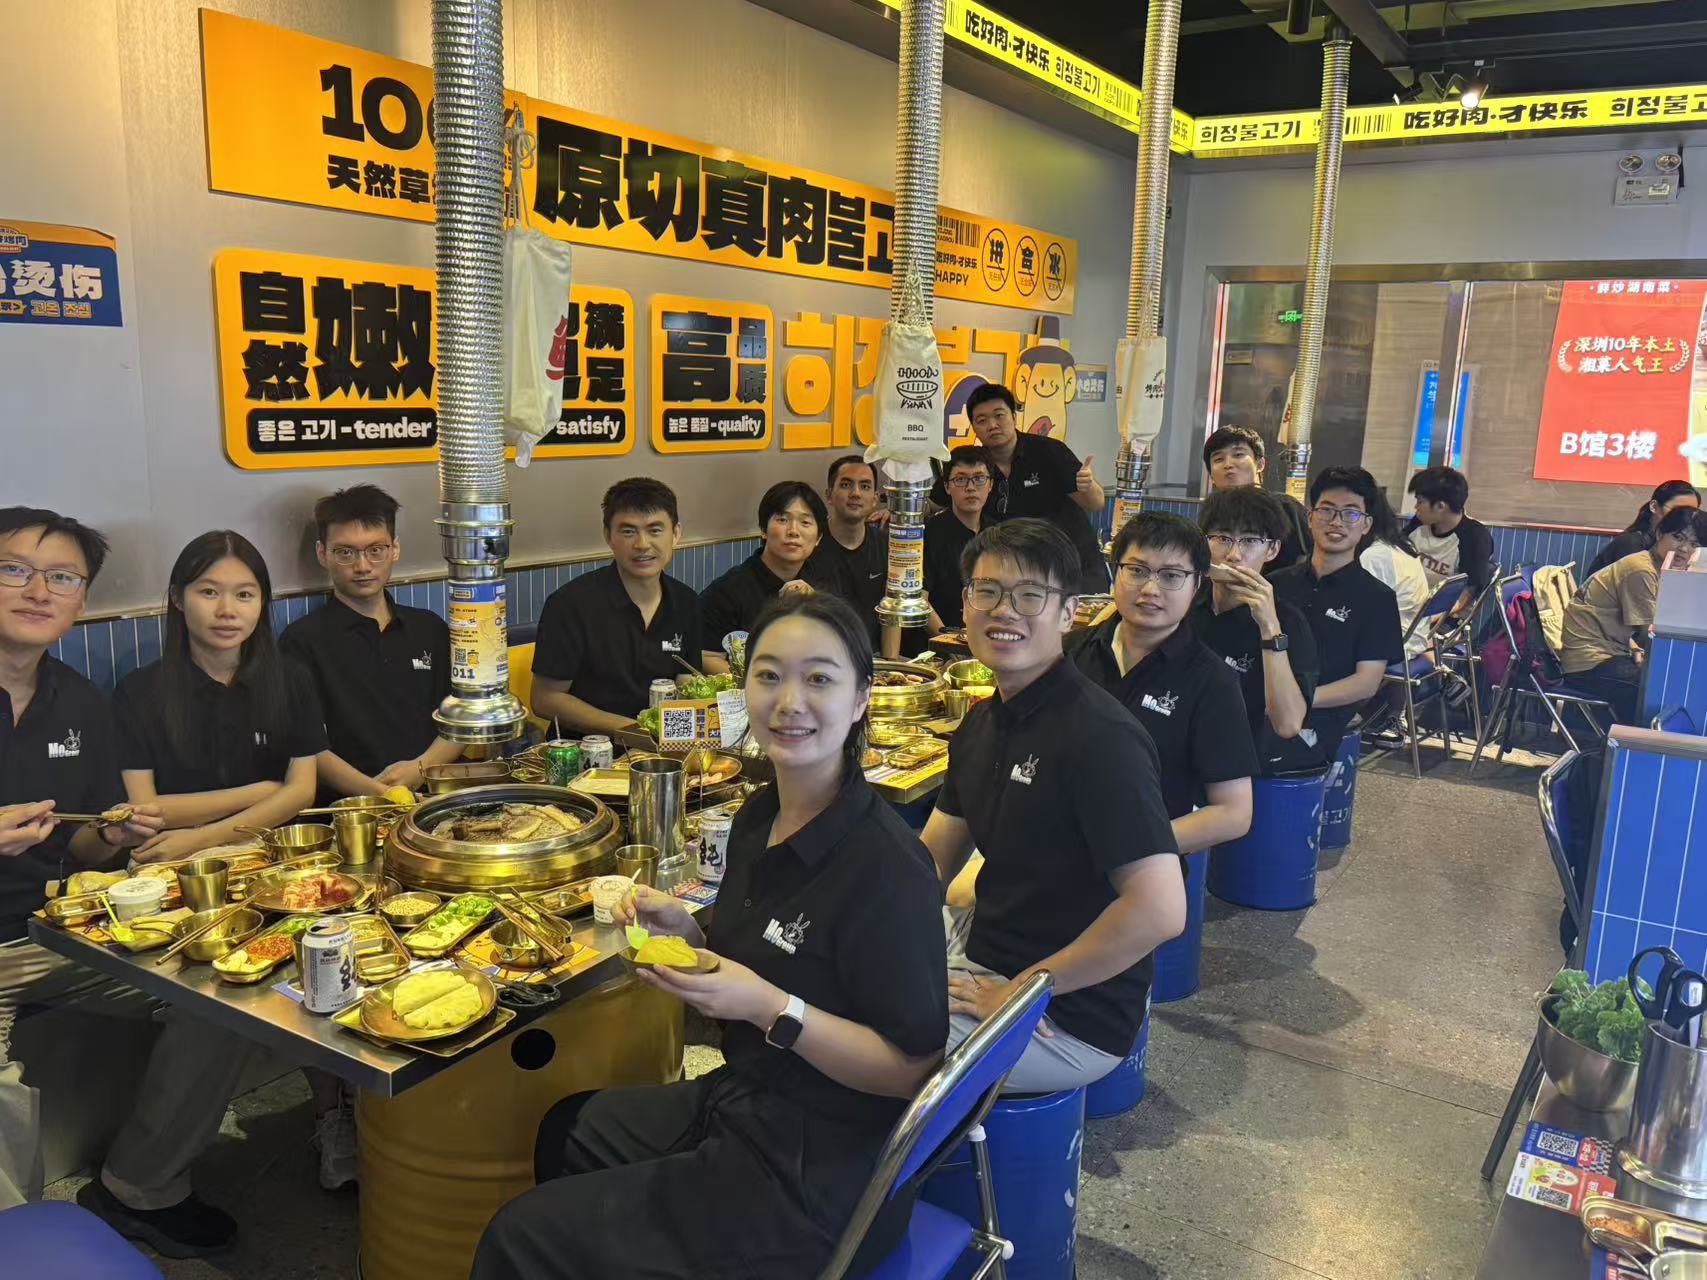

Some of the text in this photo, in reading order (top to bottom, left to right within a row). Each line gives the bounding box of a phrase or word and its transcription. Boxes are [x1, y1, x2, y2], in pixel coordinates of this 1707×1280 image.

[965, 8, 1101, 99] 吃好肉·才快乐 희정불고기
[319, 63, 435, 151] 10
[1403, 99, 1588, 130] 吃好肉·才快乐
[1199, 120, 1301, 143] 희정불고기
[327, 153, 436, 204] 天然草
[0, 259, 103, 300] 烫伤
[935, 269, 969, 286] HAPPY
[1573, 336, 1676, 353] 深圳10年本土
[1577, 357, 1665, 373] 湘菜人气王
[257, 420, 296, 442] 좋은
[301, 419, 337, 440] 고기
[556, 415, 620, 439] satisfy
[907, 423, 924, 432] BBQ
[1559, 430, 1658, 460] B馆3楼
[452, 667, 475, 679] 011
